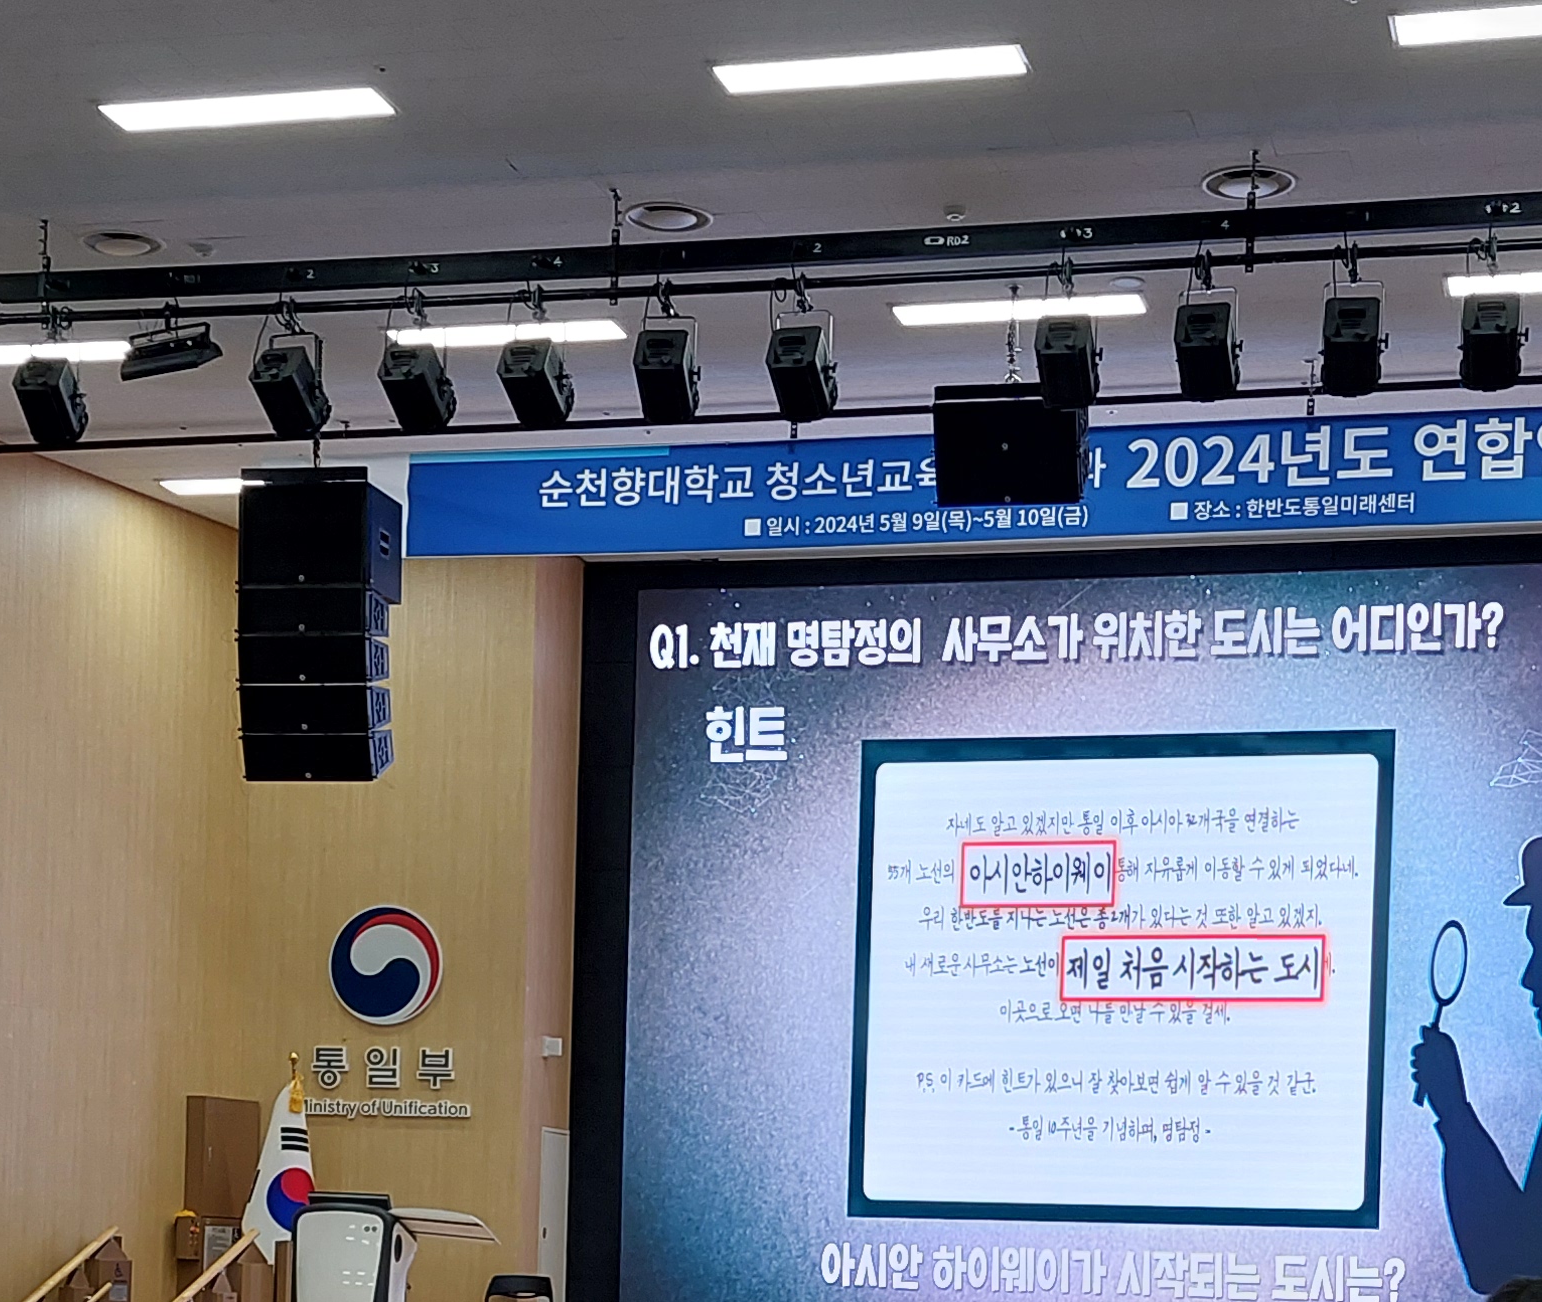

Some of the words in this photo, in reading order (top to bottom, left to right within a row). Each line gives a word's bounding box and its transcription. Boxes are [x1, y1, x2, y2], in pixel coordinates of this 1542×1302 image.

[1509, 202, 1522, 214] 2
[946, 234, 970, 247] RD2
[1220, 220, 1231, 231] 4
[812, 242, 822, 253] 2
[306, 268, 316, 280] 2
[1126, 423, 1395, 488] 2024년도
[539, 462, 754, 508] 순천향대학교
[766, 516, 801, 537] 일시
[814, 513, 875, 536] 2024년
[879, 511, 909, 534] 5월
[1016, 505, 1089, 531] 10일(금)
[1194, 500, 1231, 520] 장소
[1245, 492, 1416, 519] 한반도통일미래센터
[649, 625, 699, 669] Q1.
[709, 622, 776, 669] 천재
[787, 617, 922, 668] 명탐정의
[941, 612, 1083, 664] 사무소가
[1092, 609, 1201, 660] 위치한
[1210, 606, 1321, 658] 도시는
[1331, 601, 1504, 655] 어디인가?
[705, 705, 788, 763] 힌트
[946, 811, 986, 837] 자네도
[991, 810, 1017, 837] 알고
[1020, 810, 1074, 836] 있겠지만
[1077, 809, 1104, 836] 통일
[1110, 808, 1138, 835] 이후
[1141, 808, 1183, 835] 아시아
[1244, 805, 1300, 834] 연결하는
[915, 858, 955, 884] 노선의
[1144, 855, 1198, 883] 자유롭게
[1205, 854, 1245, 883] 이동할
[1249, 855, 1265, 881] 수
[1267, 854, 1294, 881] 있게
[918, 904, 945, 931] 우리
[950, 905, 1003, 931] 한반도를
[1006, 906, 1047, 931] 지나는
[1049, 906, 1091, 931] 노선은
[1149, 902, 1192, 929] 있다는
[1196, 902, 1209, 929] 것
[1212, 902, 1242, 930] 또한
[1246, 902, 1275, 930] 알고
[963, 951, 1018, 978] 사무소는
[1019, 951, 1060, 978] 노선이
[1066, 946, 1111, 991] 제일
[1119, 945, 1169, 991] 처음
[1172, 945, 1269, 991] 시작하는
[1274, 945, 1320, 991] 도시
[999, 998, 1053, 1024] 이곳으로
[1120, 1001, 1146, 1025] 만날
[311, 1046, 455, 1090] 통일부
[940, 1067, 952, 1093] 이
[957, 1067, 996, 1094] 카드에
[1001, 1067, 1042, 1094] 힌트가
[1044, 1069, 1083, 1094] 있으니
[1088, 1068, 1103, 1094] 잘
[1107, 1068, 1160, 1096] 찾아보면
[1164, 1069, 1192, 1096] 쉽게
[1198, 1069, 1212, 1096] 알
[1234, 1070, 1263, 1097] 있을
[1267, 1070, 1280, 1097] 것
[360, 1099, 381, 1117] of
[382, 1100, 471, 1118] Unification
[1017, 1114, 1043, 1142] 통일
[1047, 1115, 1098, 1142] 10주년을
[1162, 1116, 1200, 1144] 명탐정
[820, 1242, 923, 1291] 아시안
[933, 1244, 1107, 1296] 하이웨이가
[1117, 1249, 1258, 1301] 시작되는
